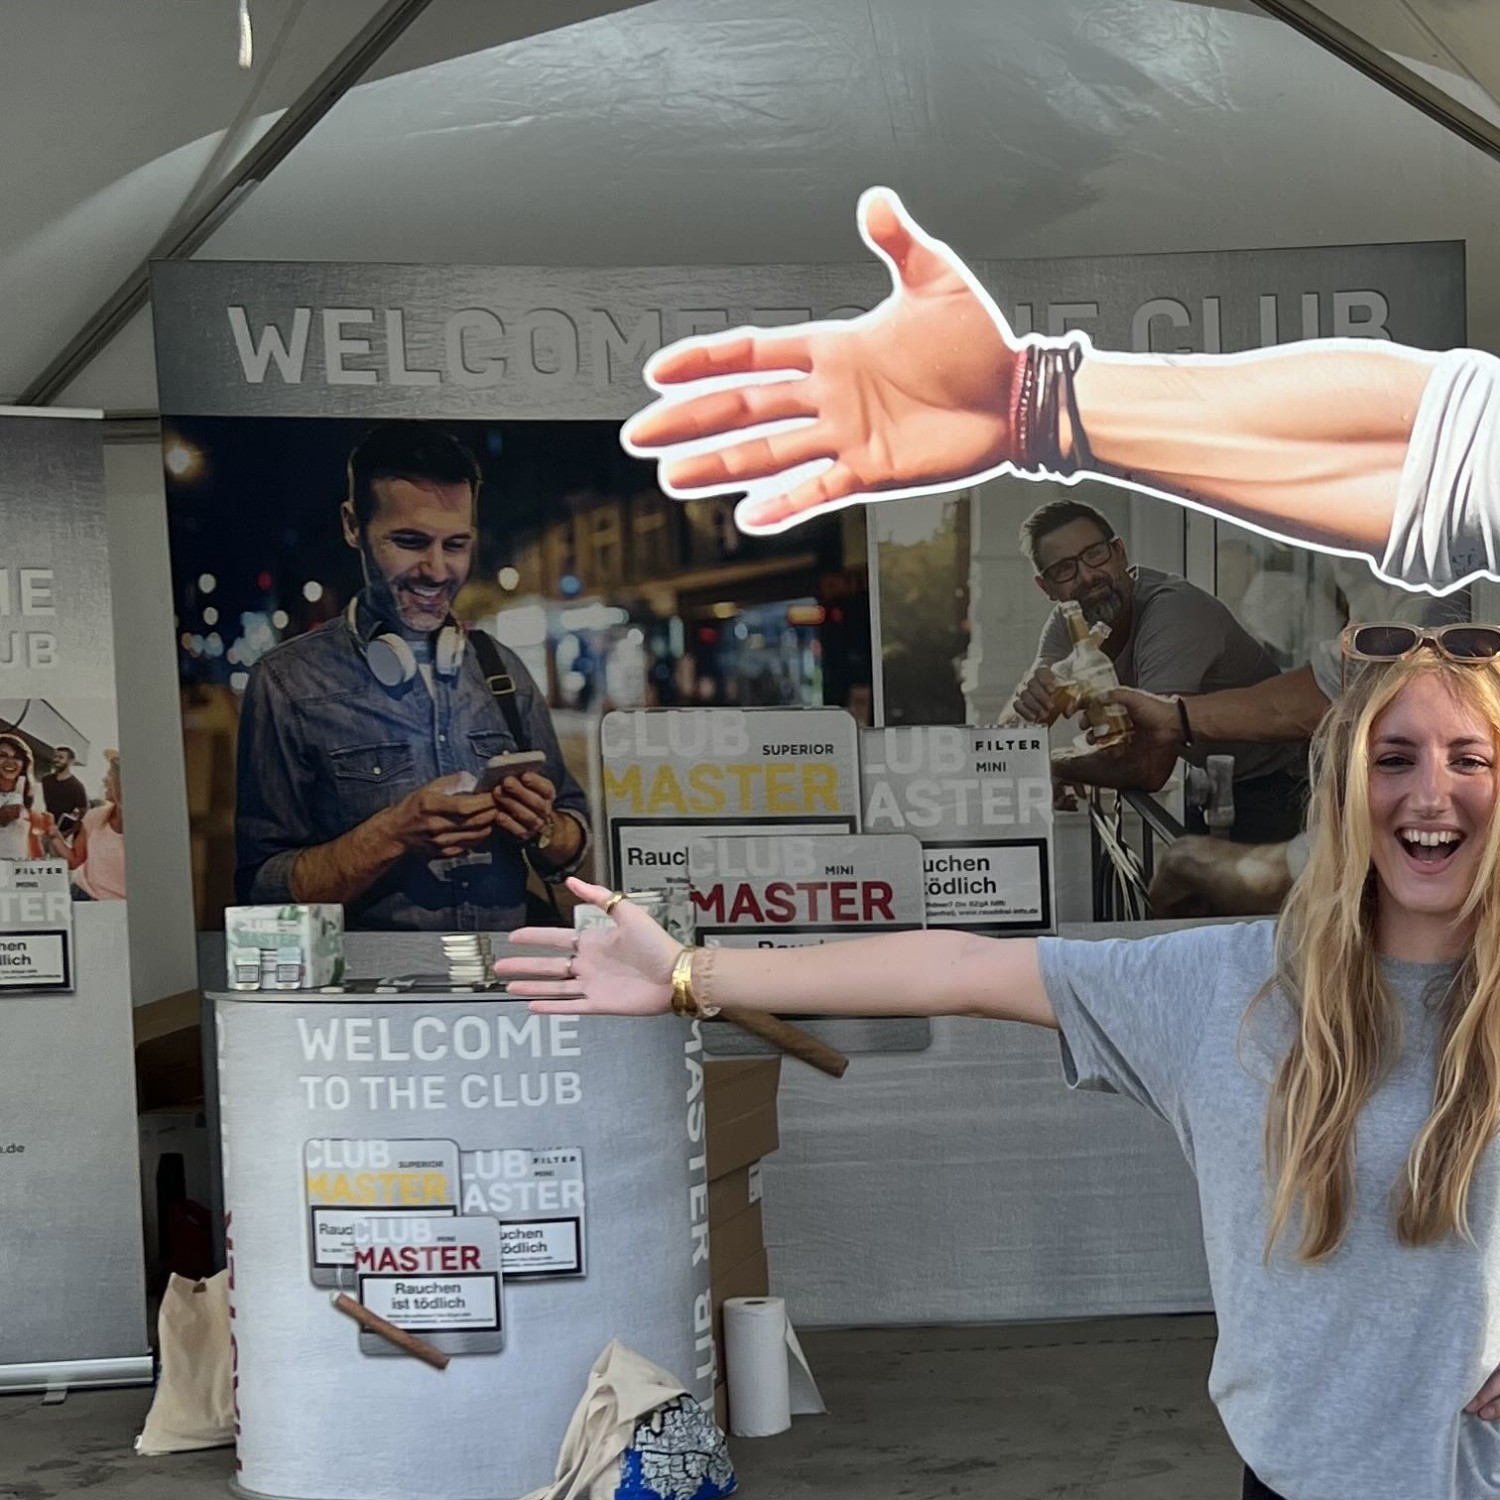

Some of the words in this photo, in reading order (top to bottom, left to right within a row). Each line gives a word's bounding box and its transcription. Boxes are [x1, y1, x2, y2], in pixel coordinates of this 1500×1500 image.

[226, 305, 728, 387] WELCOM
[762, 744, 834, 756] SUPERIOR
[975, 739, 1041, 751] FILTER
[976, 761, 1007, 773] MINI
[603, 763, 843, 815] MASTER
[864, 777, 1055, 828] ASTER
[628, 846, 689, 866] Rauc
[924, 855, 991, 873] uchen
[825, 865, 854, 876] MINI
[924, 877, 997, 895] ödlich
[689, 880, 896, 924] MASTER
[297, 1015, 582, 1062] WELCOME
[299, 1074, 351, 1111] TO
[359, 1073, 448, 1111] THE
[460, 1071, 583, 1109] CLUB
[306, 1140, 393, 1169] CLUB
[306, 1171, 449, 1205] MASTER
[463, 1180, 585, 1213] ASTER
[319, 1223, 355, 1236] Rauc
[355, 1218, 432, 1244] CLUB
[500, 1229, 544, 1240] uchen
[355, 1244, 482, 1272] MASTER
[395, 1282, 461, 1295] Rauchen
[391, 1297, 411, 1310] ist
[414, 1296, 466, 1310] tödlich
